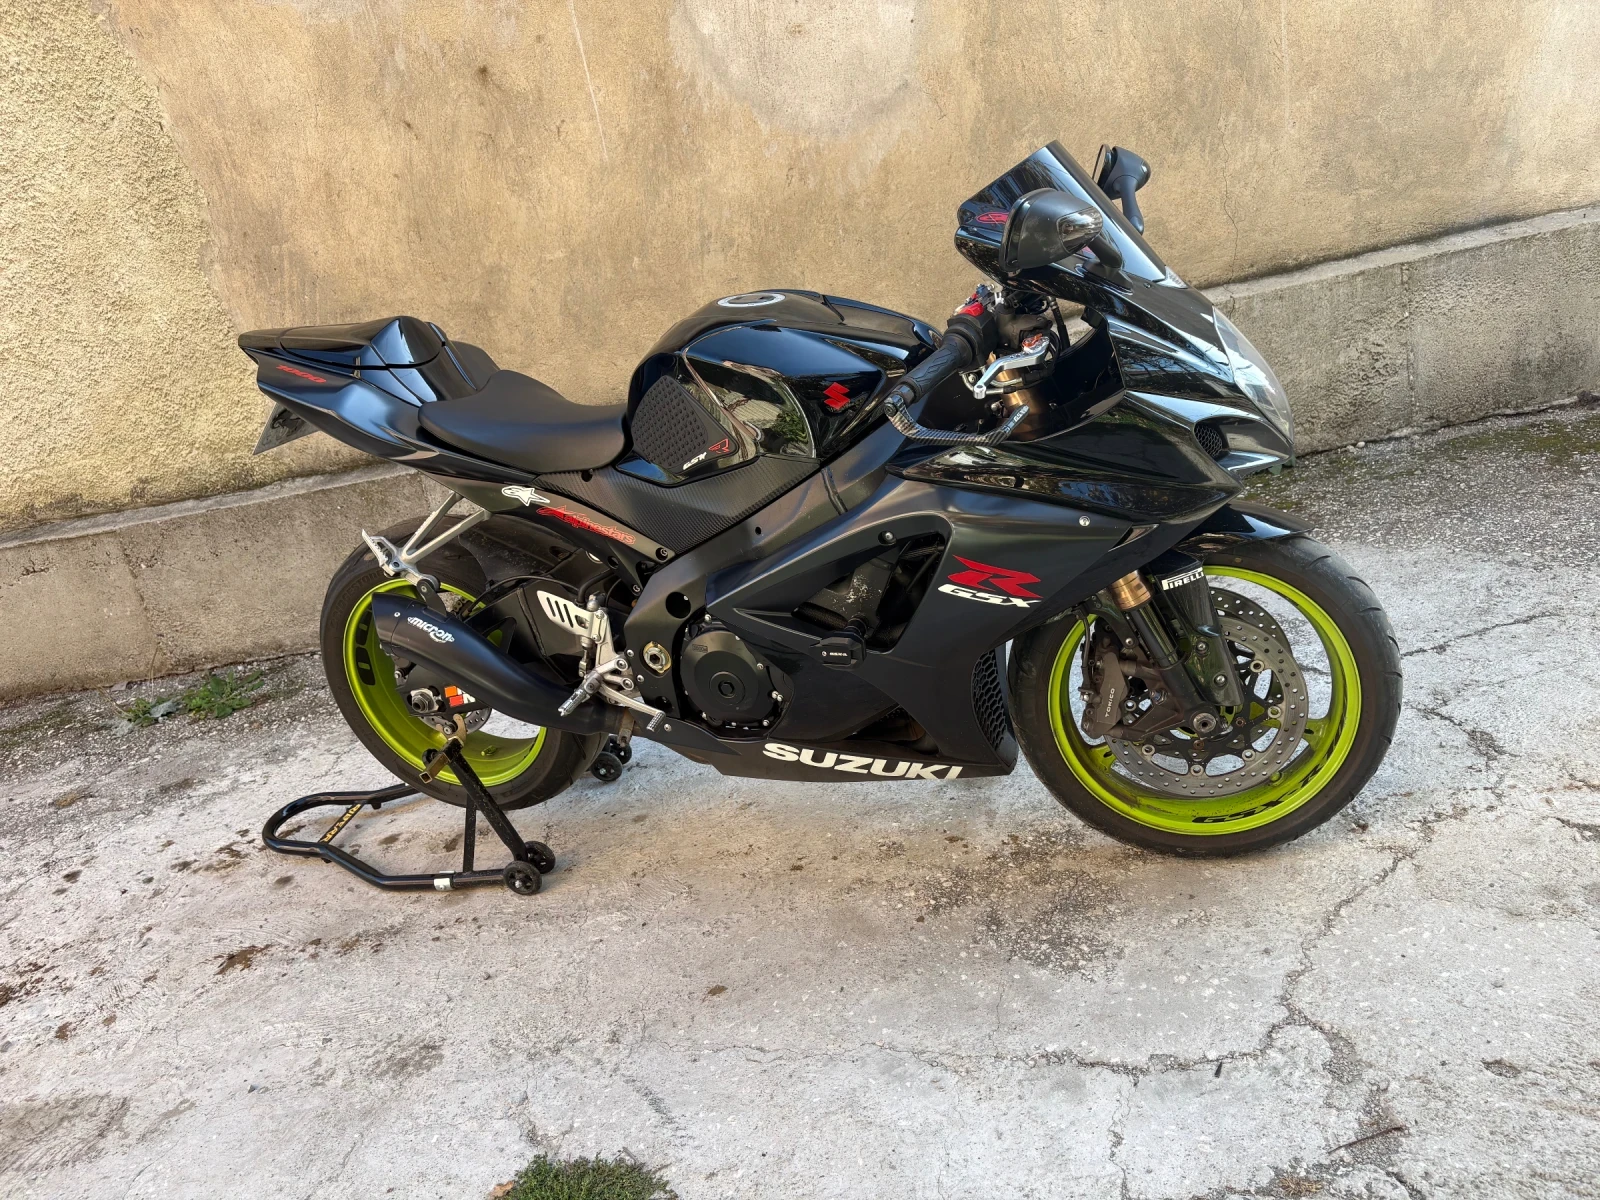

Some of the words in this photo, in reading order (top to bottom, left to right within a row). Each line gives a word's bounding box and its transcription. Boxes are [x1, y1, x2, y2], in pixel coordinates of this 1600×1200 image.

[276, 365, 326, 383] 1000
[1161, 567, 1204, 590] PIRELLI
[938, 583, 1042, 608] GSX
[408, 616, 455, 643] micron
[1105, 688, 1115, 718] TOKICO
[762, 742, 963, 780] SUZUKI
